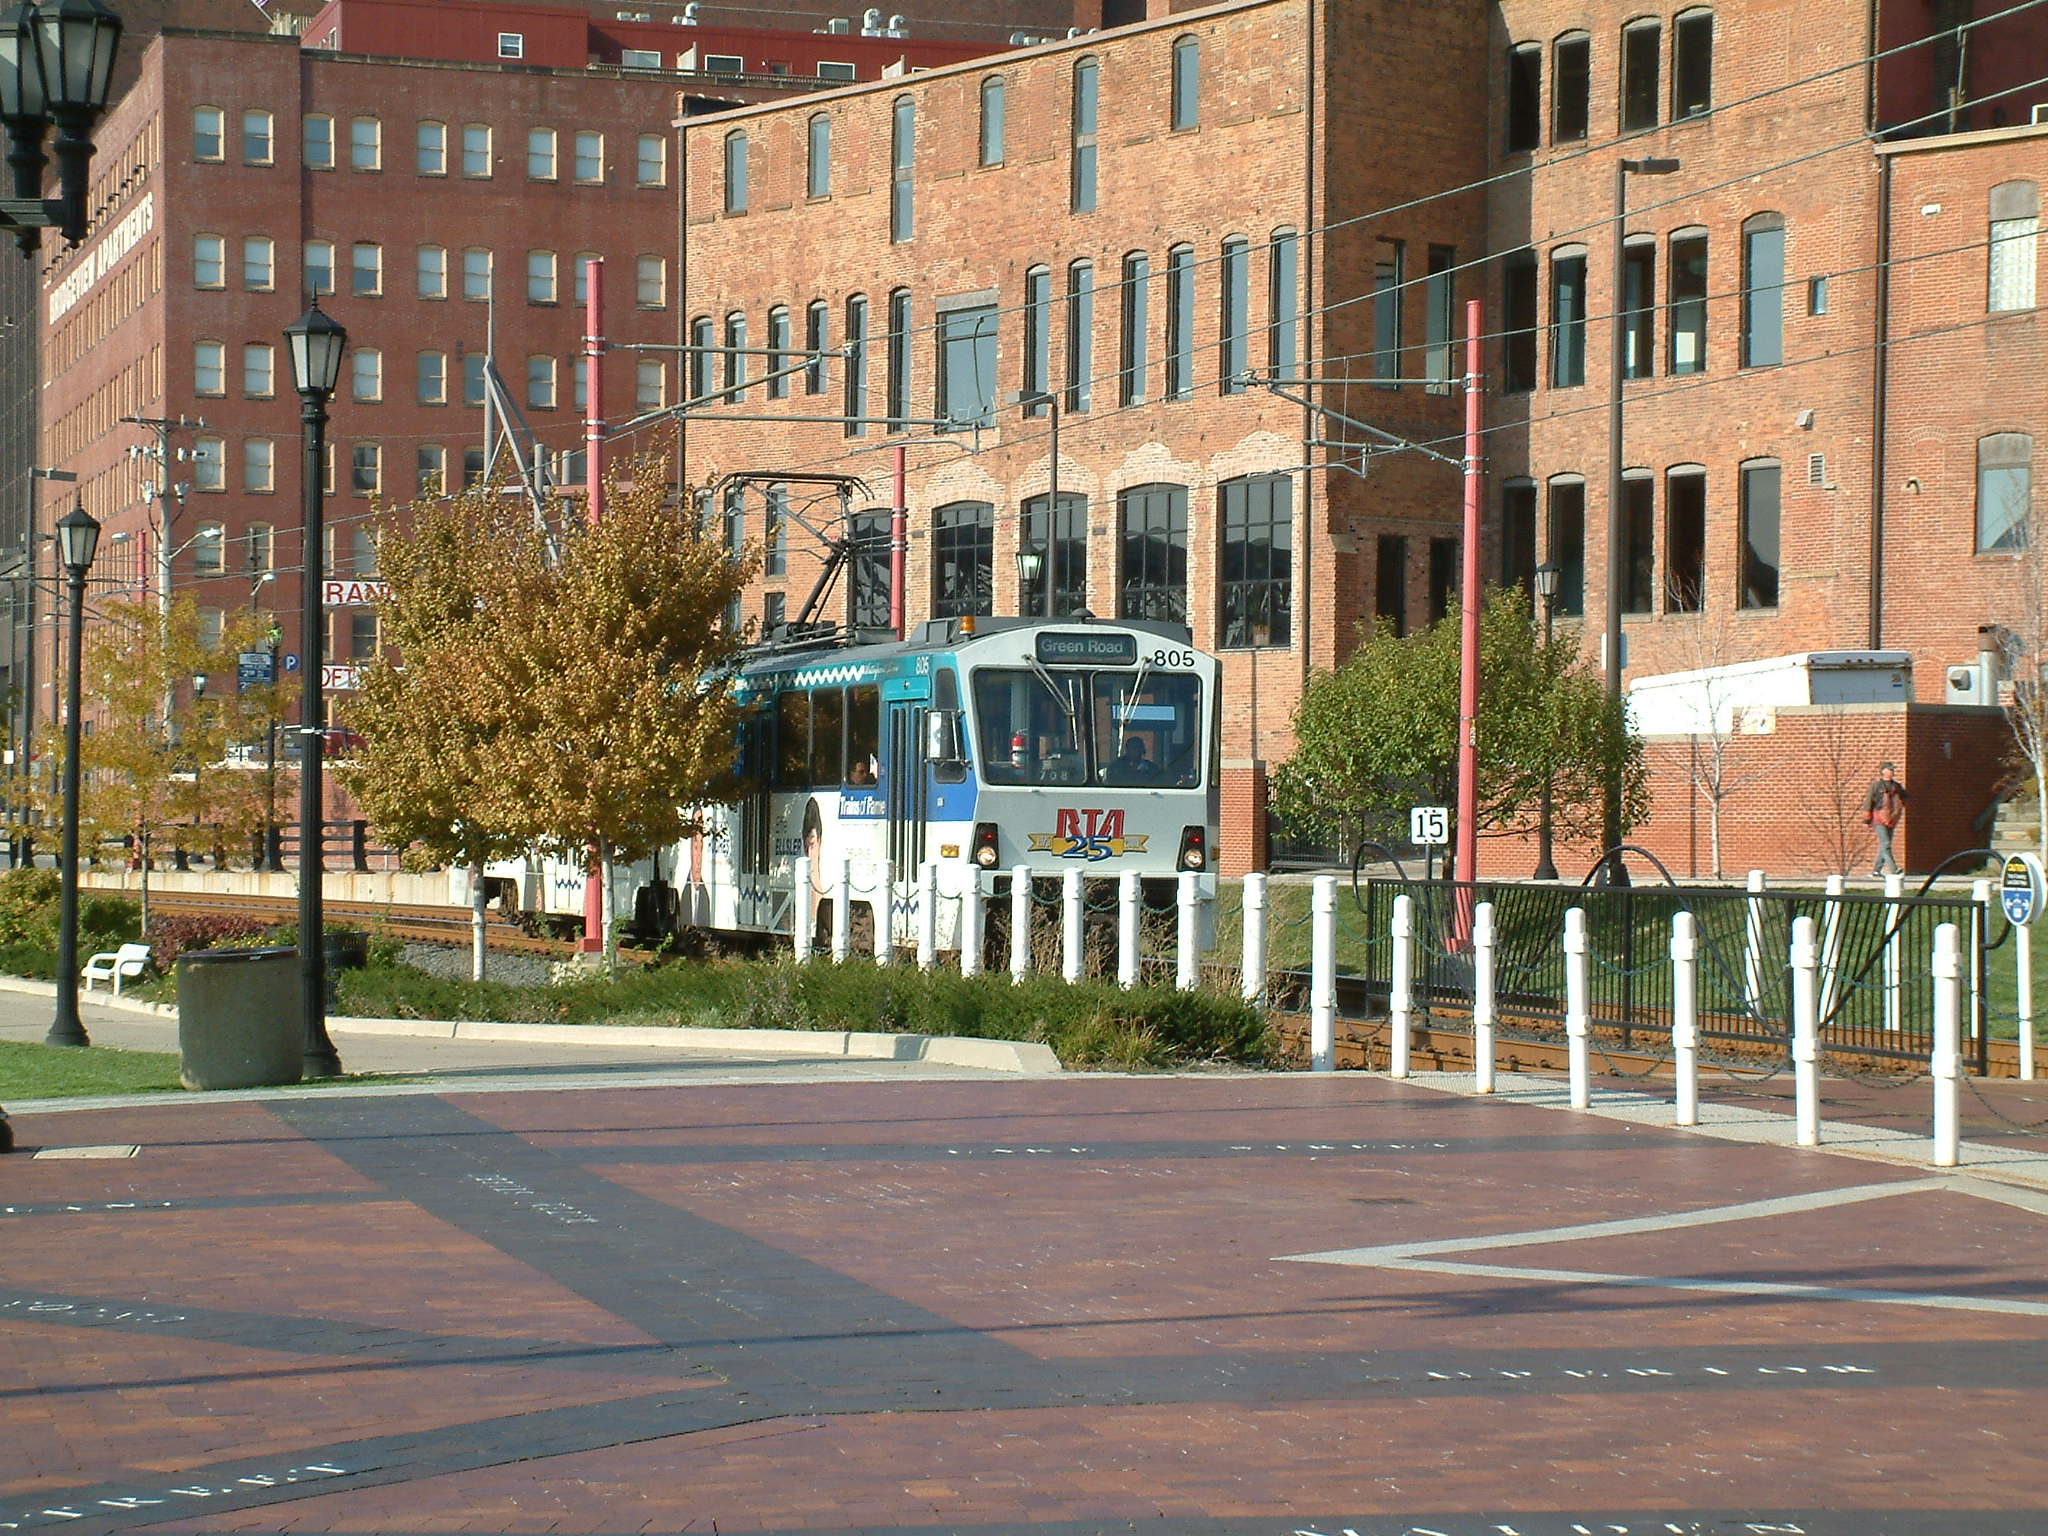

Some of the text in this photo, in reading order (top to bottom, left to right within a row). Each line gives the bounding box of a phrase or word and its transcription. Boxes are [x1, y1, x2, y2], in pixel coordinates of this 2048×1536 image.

[97, 191, 154, 281] APARTMENTS
[1041, 639, 1124, 653] Green Road
[915, 656, 930, 675] 805
[1153, 650, 1195, 667] 805
[839, 796, 860, 816] Trains
[1055, 808, 1125, 839] RTA
[1416, 814, 1443, 838] 15
[1062, 835, 1113, 862] 25
